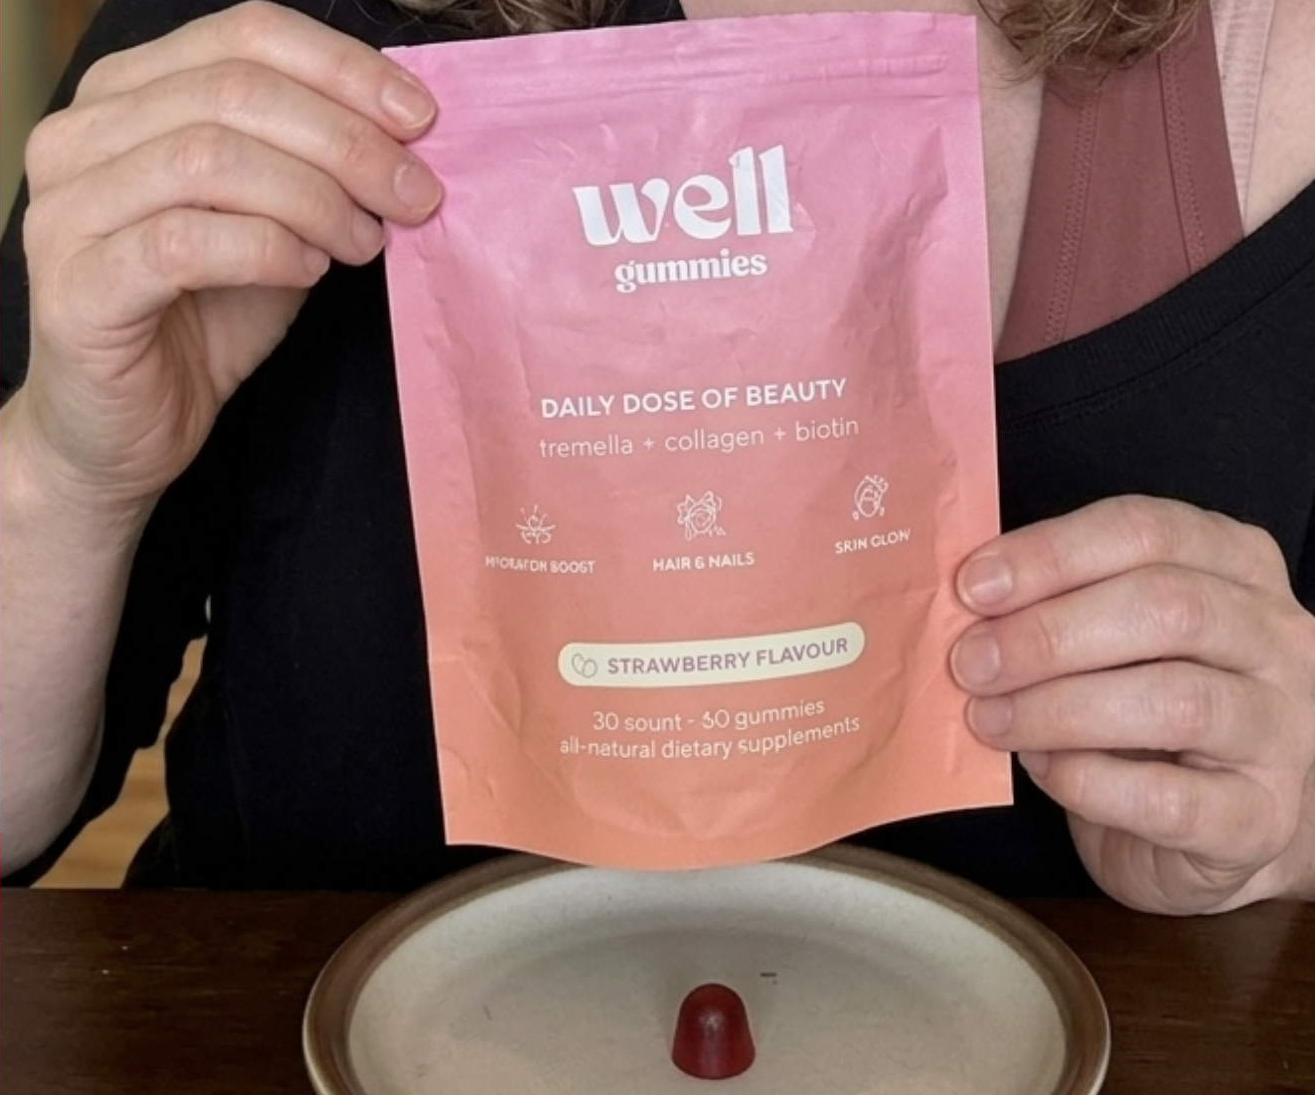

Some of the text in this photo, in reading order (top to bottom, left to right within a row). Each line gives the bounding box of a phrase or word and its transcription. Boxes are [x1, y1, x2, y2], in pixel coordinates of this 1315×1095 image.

[572, 145, 793, 246] well
[615, 248, 768, 293] gummies
[541, 378, 847, 418] DAILY DOSE OF BEAUTY
[540, 434, 633, 459] tremella
[665, 429, 764, 453] collagen
[796, 418, 860, 442] biotin
[653, 557, 692, 572] HAIR
[708, 552, 756, 569] NAILS
[607, 637, 848, 675] STRAWBERRY FLAVOUR
[592, 711, 620, 731] 30
[735, 699, 826, 730] gummies
[559, 715, 861, 761] all-natural dietary supplements
